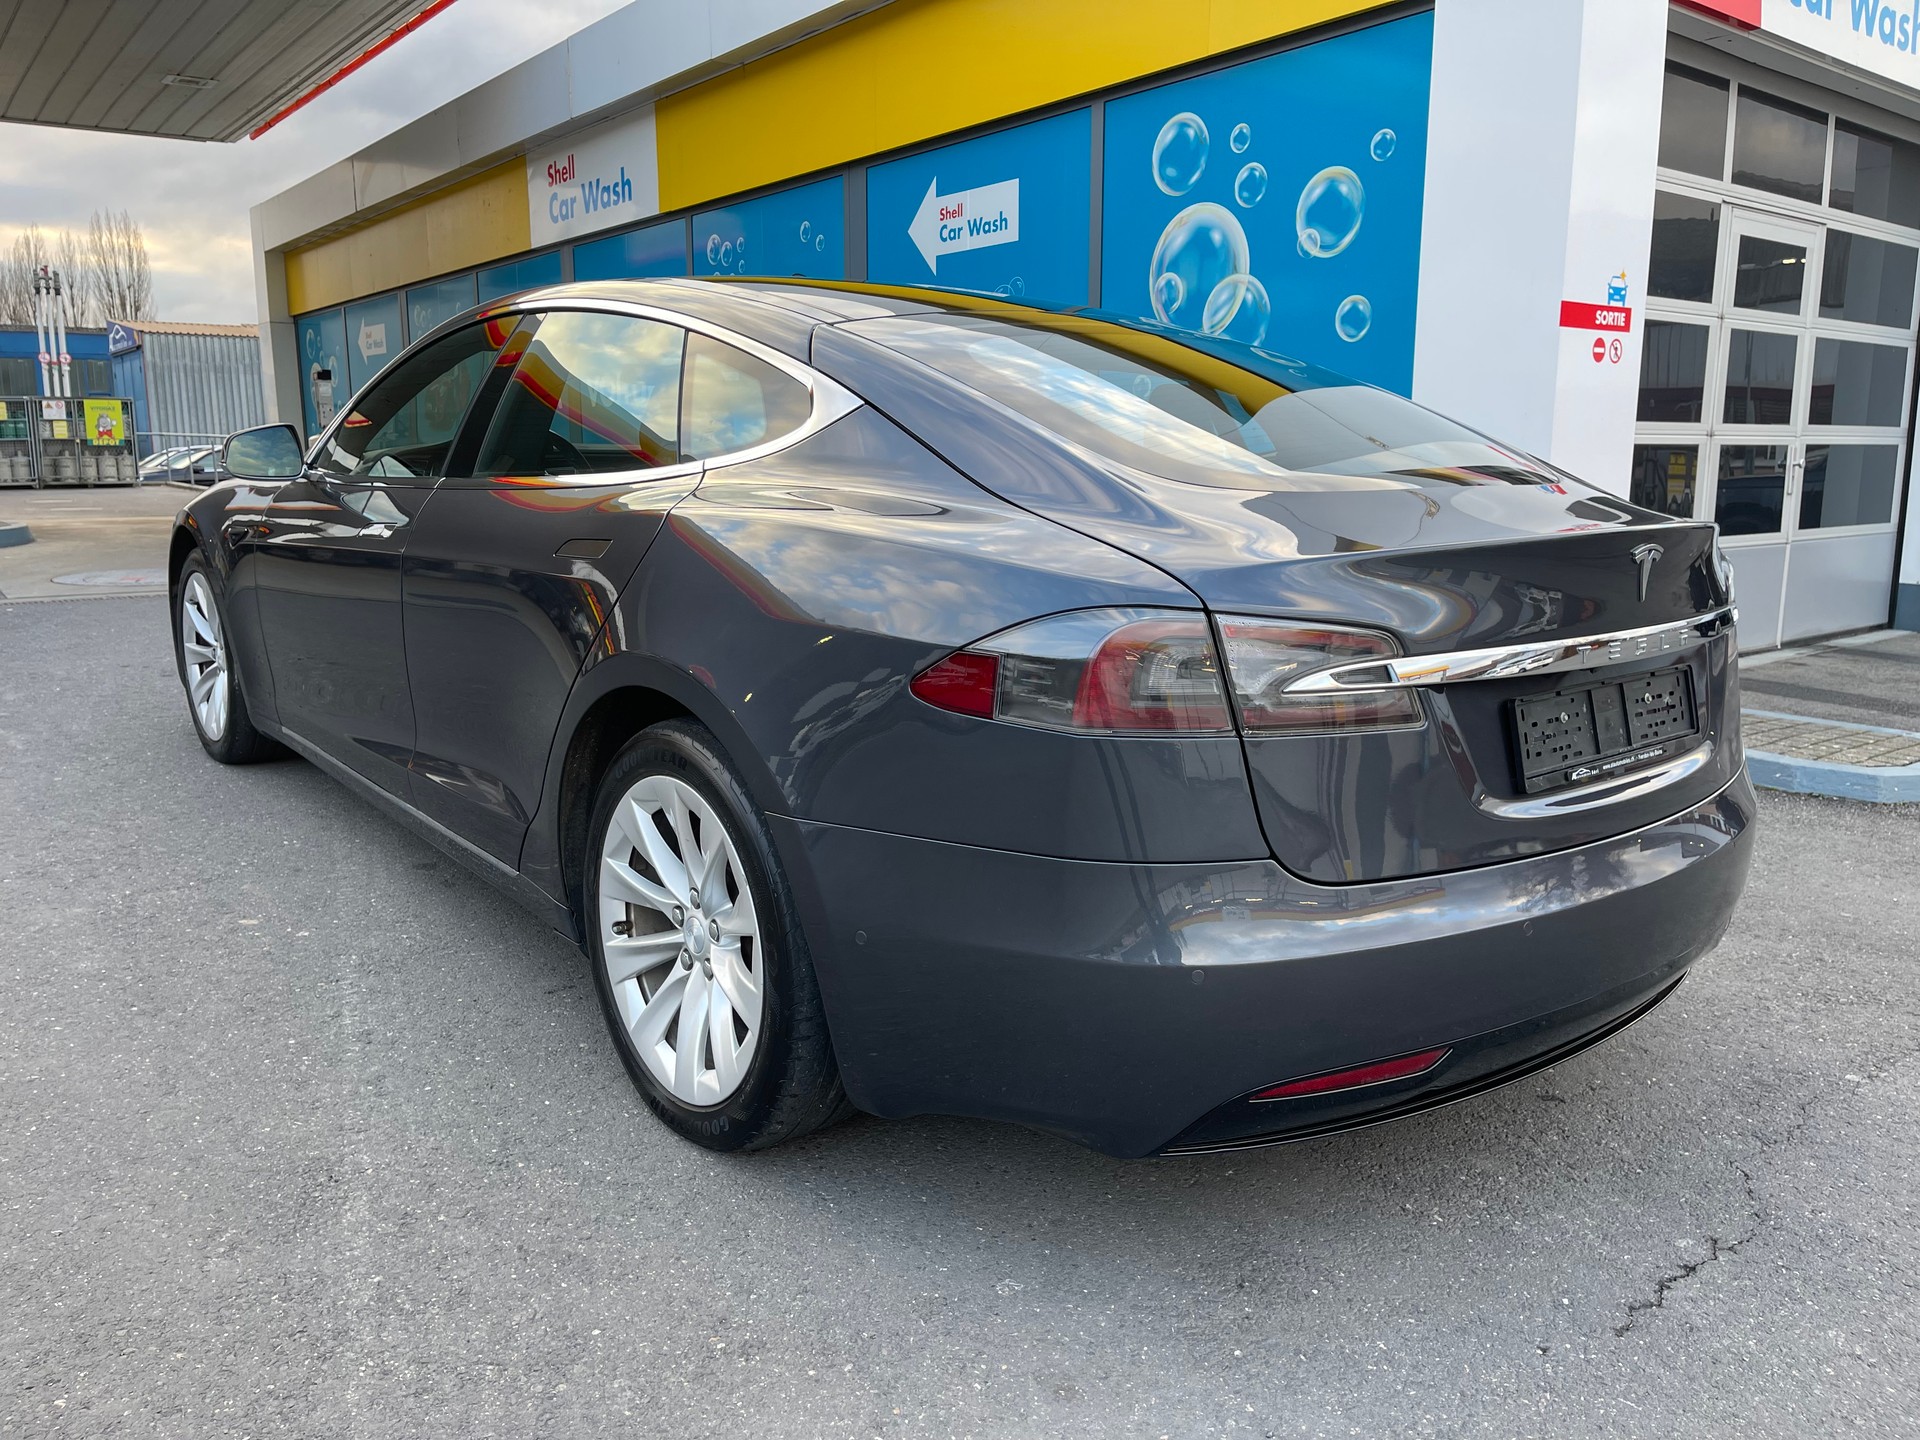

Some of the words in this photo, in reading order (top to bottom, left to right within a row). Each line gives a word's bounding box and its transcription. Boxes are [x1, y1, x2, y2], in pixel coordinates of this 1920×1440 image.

[547, 153, 575, 187] Shell
[549, 191, 577, 224] Car
[581, 166, 632, 214] Wash
[939, 202, 963, 221] Shell
[939, 224, 963, 243] Car
[967, 210, 1008, 237] Wash
[1595, 309, 1626, 327] SORTIE
[1576, 628, 1689, 665] TESLA
